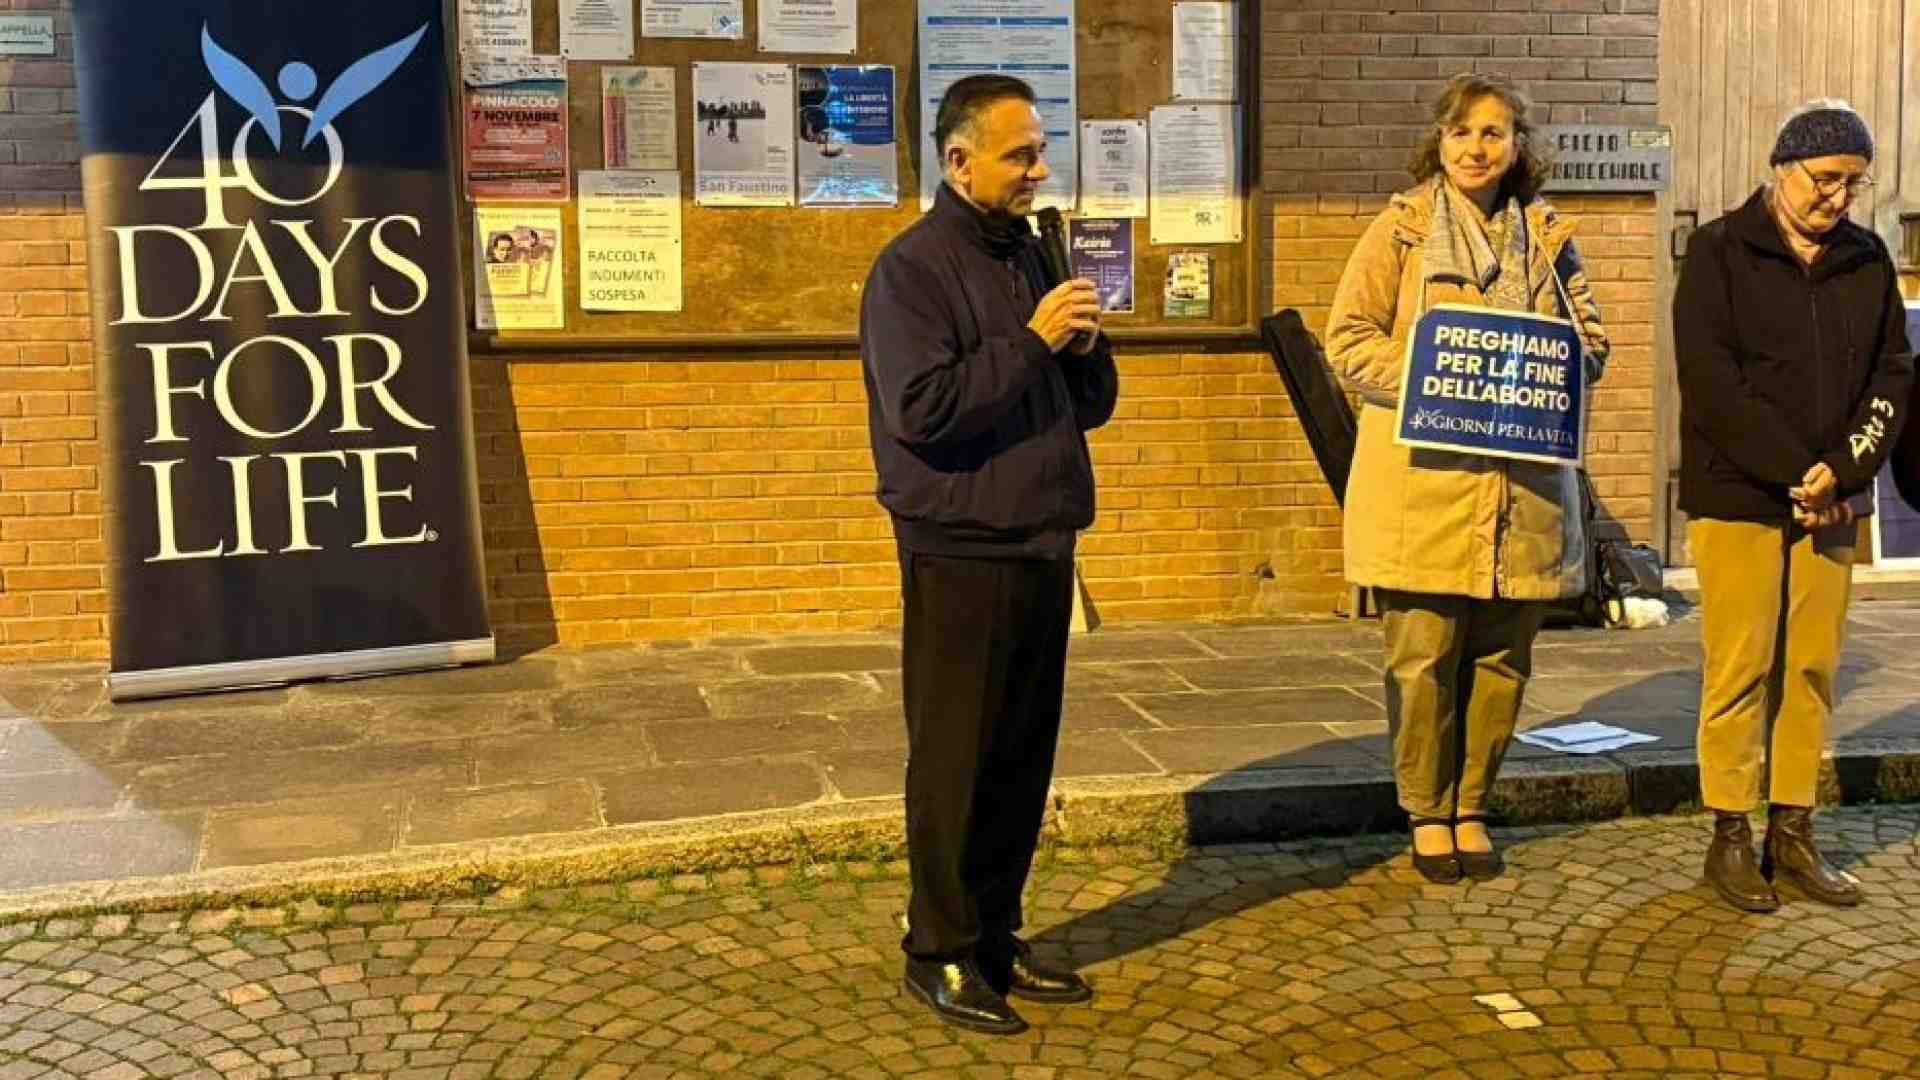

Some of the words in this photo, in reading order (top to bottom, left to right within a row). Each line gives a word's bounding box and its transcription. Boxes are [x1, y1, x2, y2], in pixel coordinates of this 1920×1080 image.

[1, 24, 47, 35] APPELLA
[472, 95, 559, 108] PINNACOLO
[471, 111, 481, 122] 7
[484, 111, 560, 122] NOVEMBRE
[1559, 133, 1619, 152] FICIO
[139, 90, 344, 230] 40
[700, 181, 725, 193] San
[729, 180, 786, 193] Faustino
[587, 250, 656, 263] RACCOLTA
[104, 216, 429, 325] DAYS
[588, 270, 666, 282] INDUMENTI
[588, 289, 646, 301] SOSPESA
[1433, 325, 1569, 360] PREGHIAMO
[1436, 351, 1482, 375] PER
[1488, 358, 1519, 380] LA
[1524, 362, 1568, 386] FINE
[135, 333, 436, 443] FOR
[1422, 375, 1571, 412] DELL'ABORTO
[1497, 423, 1528, 440] PER
[138, 446, 427, 562] LIFE
